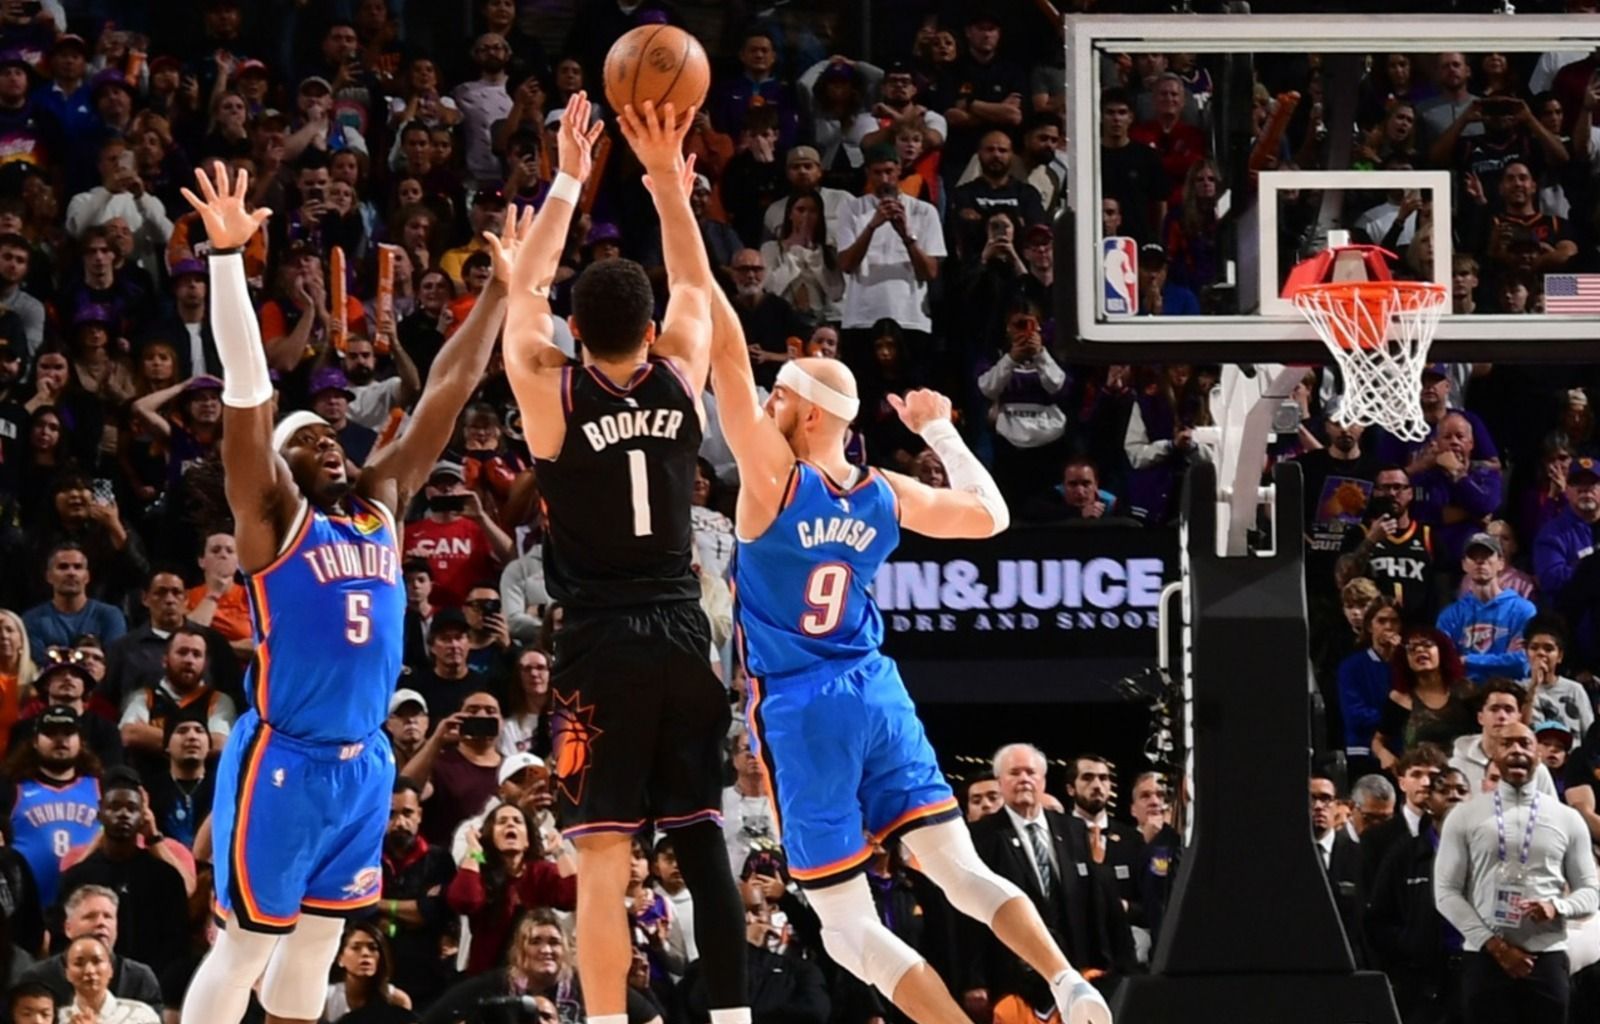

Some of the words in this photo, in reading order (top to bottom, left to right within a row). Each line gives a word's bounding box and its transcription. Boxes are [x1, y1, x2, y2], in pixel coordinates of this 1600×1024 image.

[581, 408, 684, 452] BOOKER
[626, 448, 653, 536] 1
[797, 517, 877, 552] CARUSO
[303, 541, 397, 586] THUNDER
[872, 557, 1164, 611] IN&JUICE
[1369, 556, 1425, 582] PHX
[345, 591, 371, 645] 5
[799, 561, 852, 638] 9
[891, 613, 957, 632] DRE
[973, 611, 1040, 631] AND
[24, 802, 97, 828] THUNDER
[53, 829, 70, 857] 8
